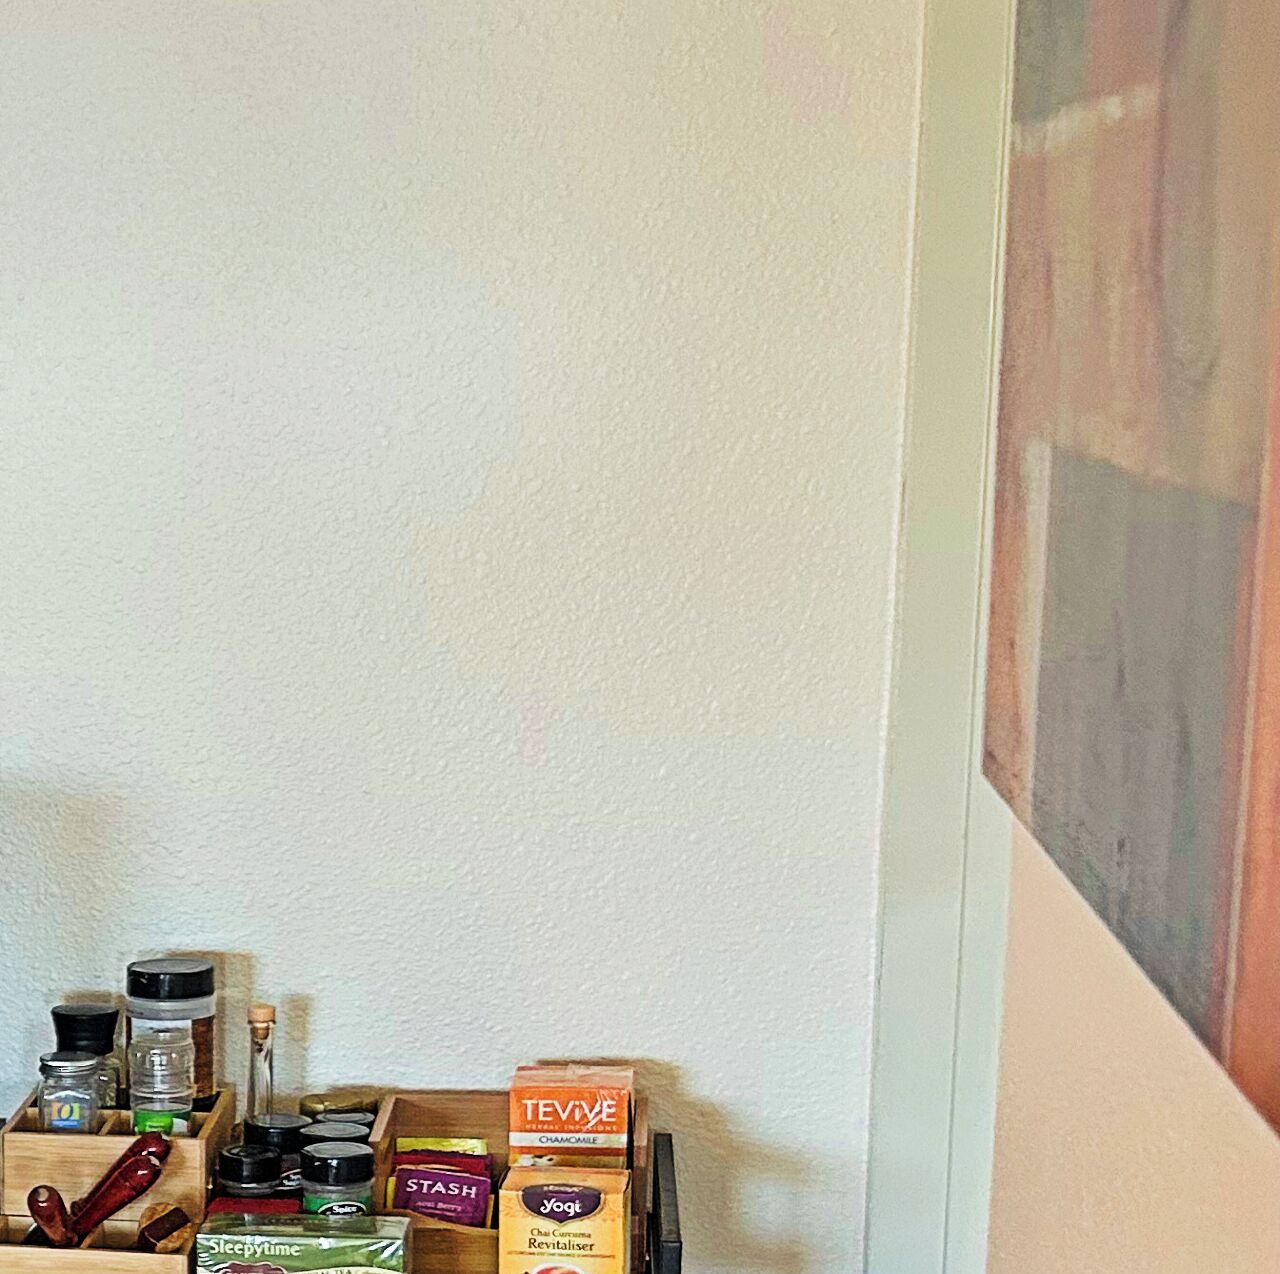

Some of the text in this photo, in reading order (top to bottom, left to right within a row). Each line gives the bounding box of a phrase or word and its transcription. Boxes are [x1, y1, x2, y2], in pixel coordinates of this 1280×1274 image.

[538, 1135, 598, 1145] CHAMOMILE
[405, 1178, 477, 1199] STASH
[530, 1228, 592, 1238] Chai Curcuma
[208, 1239, 300, 1258] Sleepytime
[528, 1238, 595, 1251] Revitaliser
